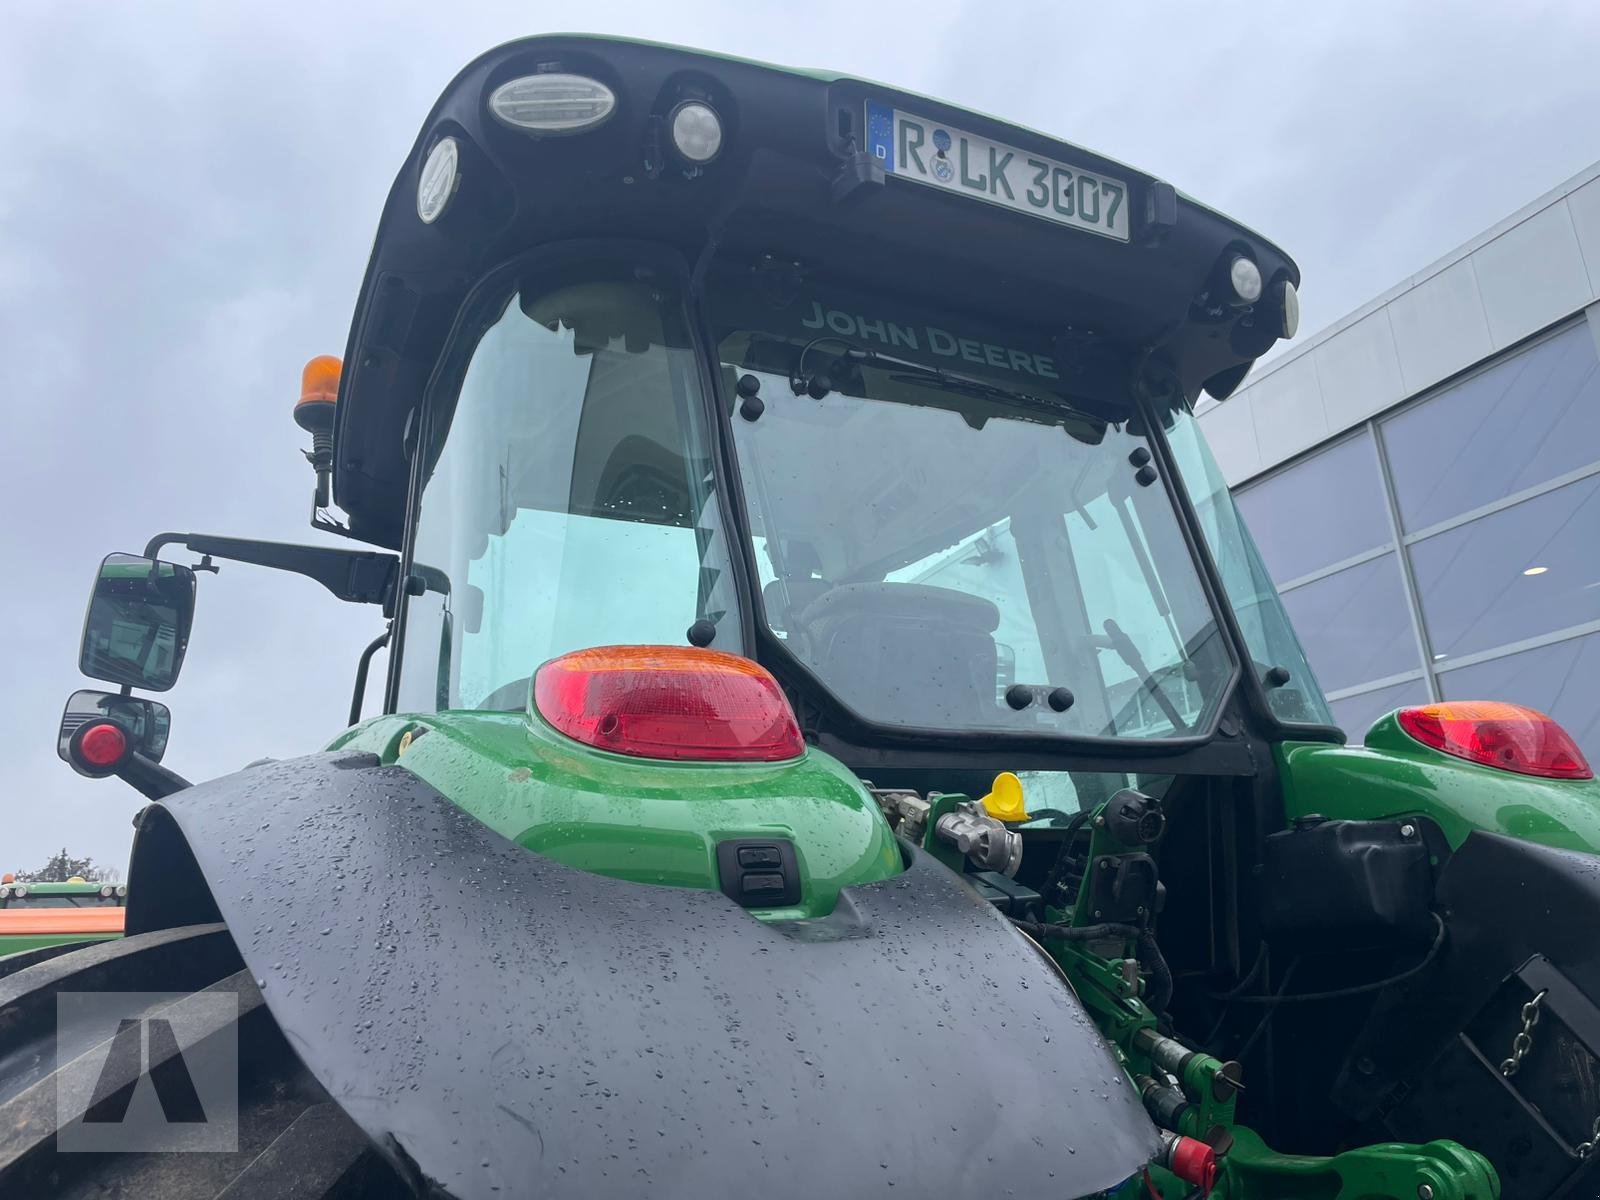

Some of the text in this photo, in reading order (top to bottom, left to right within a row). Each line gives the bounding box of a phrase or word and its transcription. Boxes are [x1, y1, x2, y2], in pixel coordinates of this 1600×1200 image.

[875, 144, 886, 159] D
[899, 119, 1124, 229] R LK 3007
[801, 301, 1059, 378] JOHN DEERE
